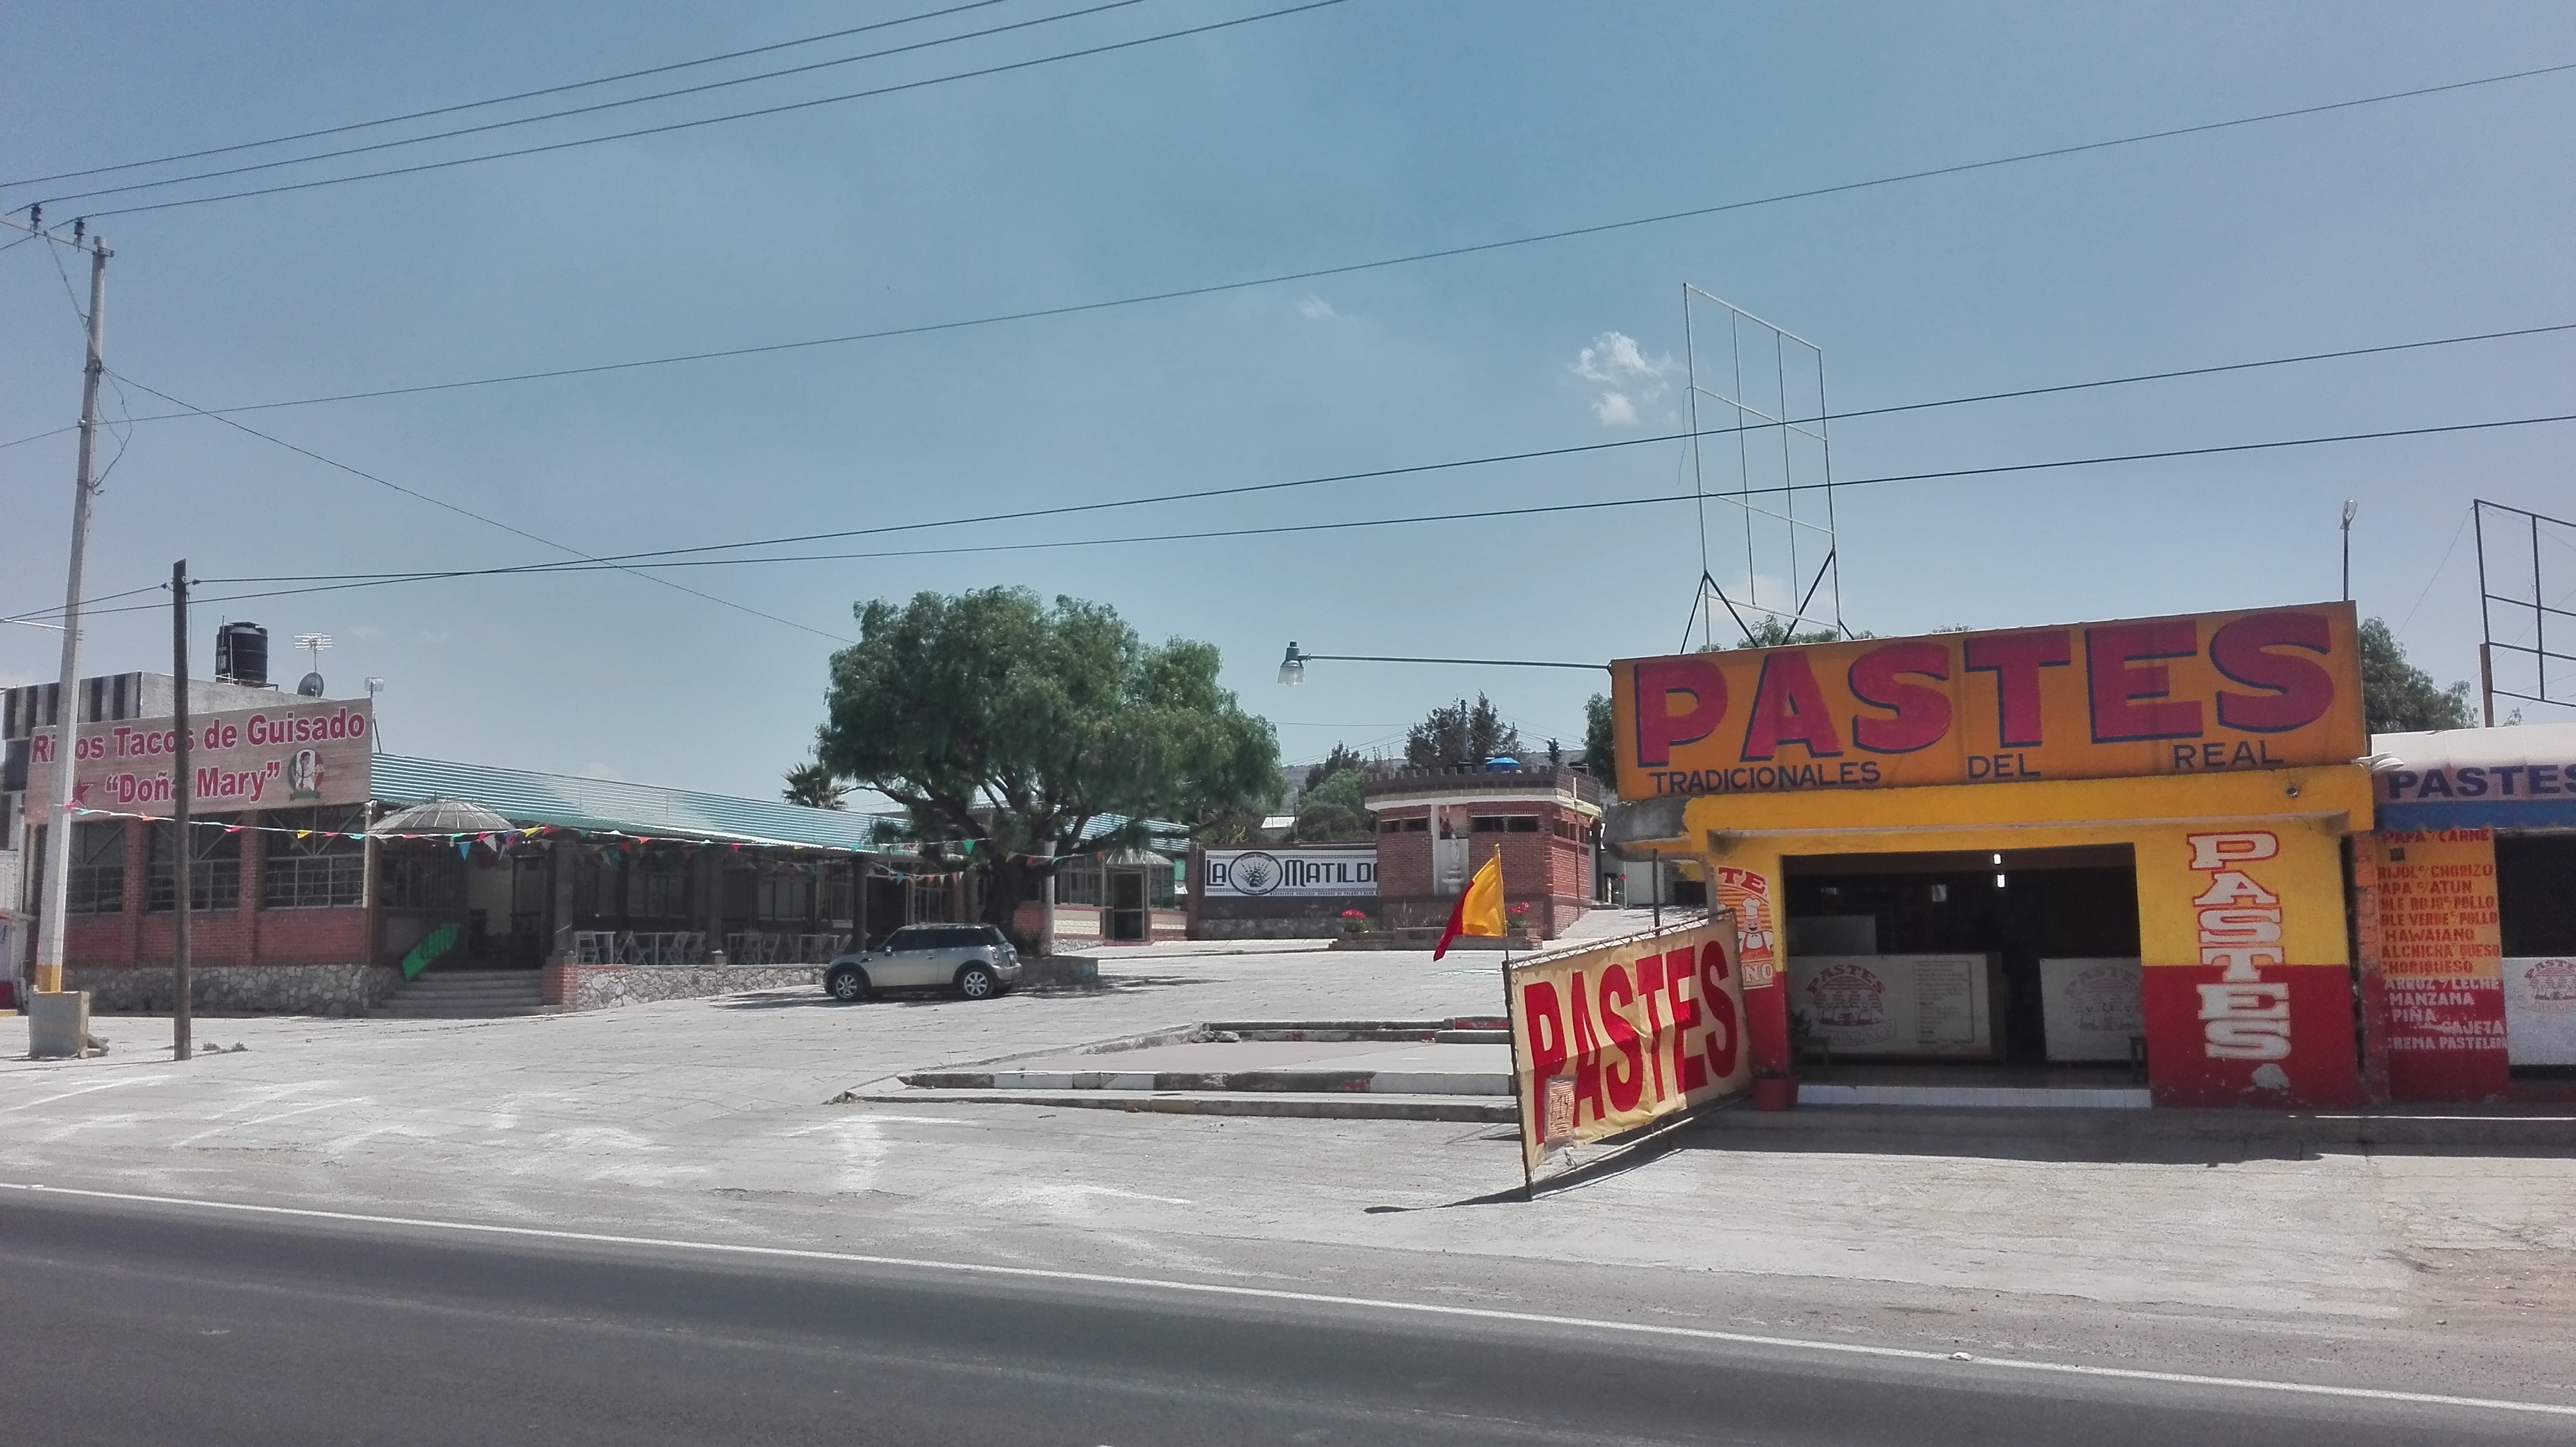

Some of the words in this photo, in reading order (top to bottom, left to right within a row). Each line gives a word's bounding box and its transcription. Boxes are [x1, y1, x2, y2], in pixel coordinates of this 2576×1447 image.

[1634, 613, 2335, 768] PASTES
[31, 733, 105, 764] Rios
[204, 719, 237, 750] de
[247, 707, 365, 746] Guisado
[105, 770, 176, 804] “Doñ
[1650, 761, 1881, 795] TRADICIONALES
[1967, 753, 2042, 780] DEL
[2174, 741, 2285, 770] REAL
[1206, 859, 1226, 886] LA
[2187, 831, 2292, 1060] PASTES
[1806, 964, 1886, 994] PASTES
[2063, 966, 2143, 999] PASTE
[2451, 977, 2500, 990] LECHE
[1524, 940, 1738, 1146] PASTES
